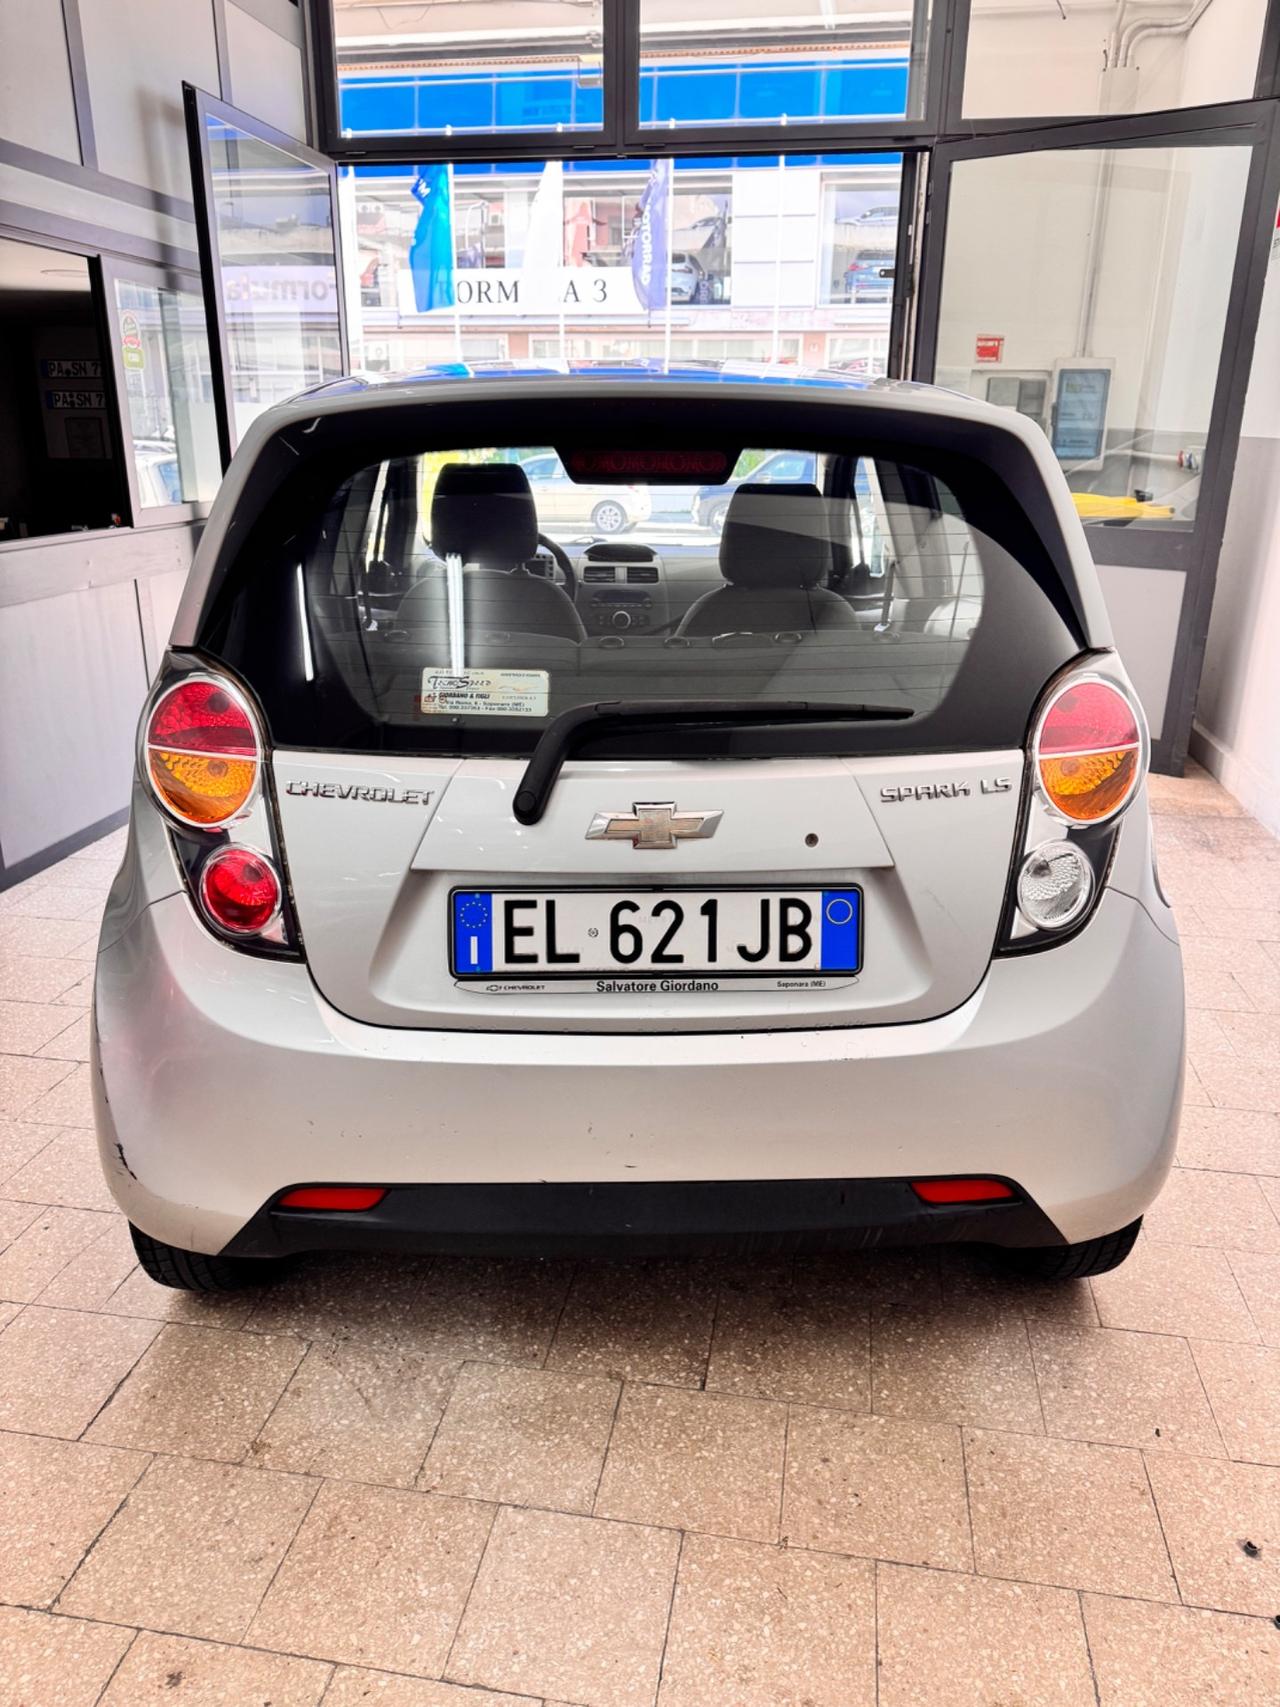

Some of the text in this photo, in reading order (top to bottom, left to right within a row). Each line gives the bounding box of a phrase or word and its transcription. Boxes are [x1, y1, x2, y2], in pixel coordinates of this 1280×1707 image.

[593, 279, 607, 302] 3
[286, 781, 435, 805] CHEVROLET
[880, 777, 1013, 803] SPARK LS
[504, 899, 581, 964] EL
[596, 980, 657, 992] Salvatore
[660, 979, 719, 992] Giordano
[777, 980, 809, 988] Saponara
[810, 980, 827, 988] (ME)
